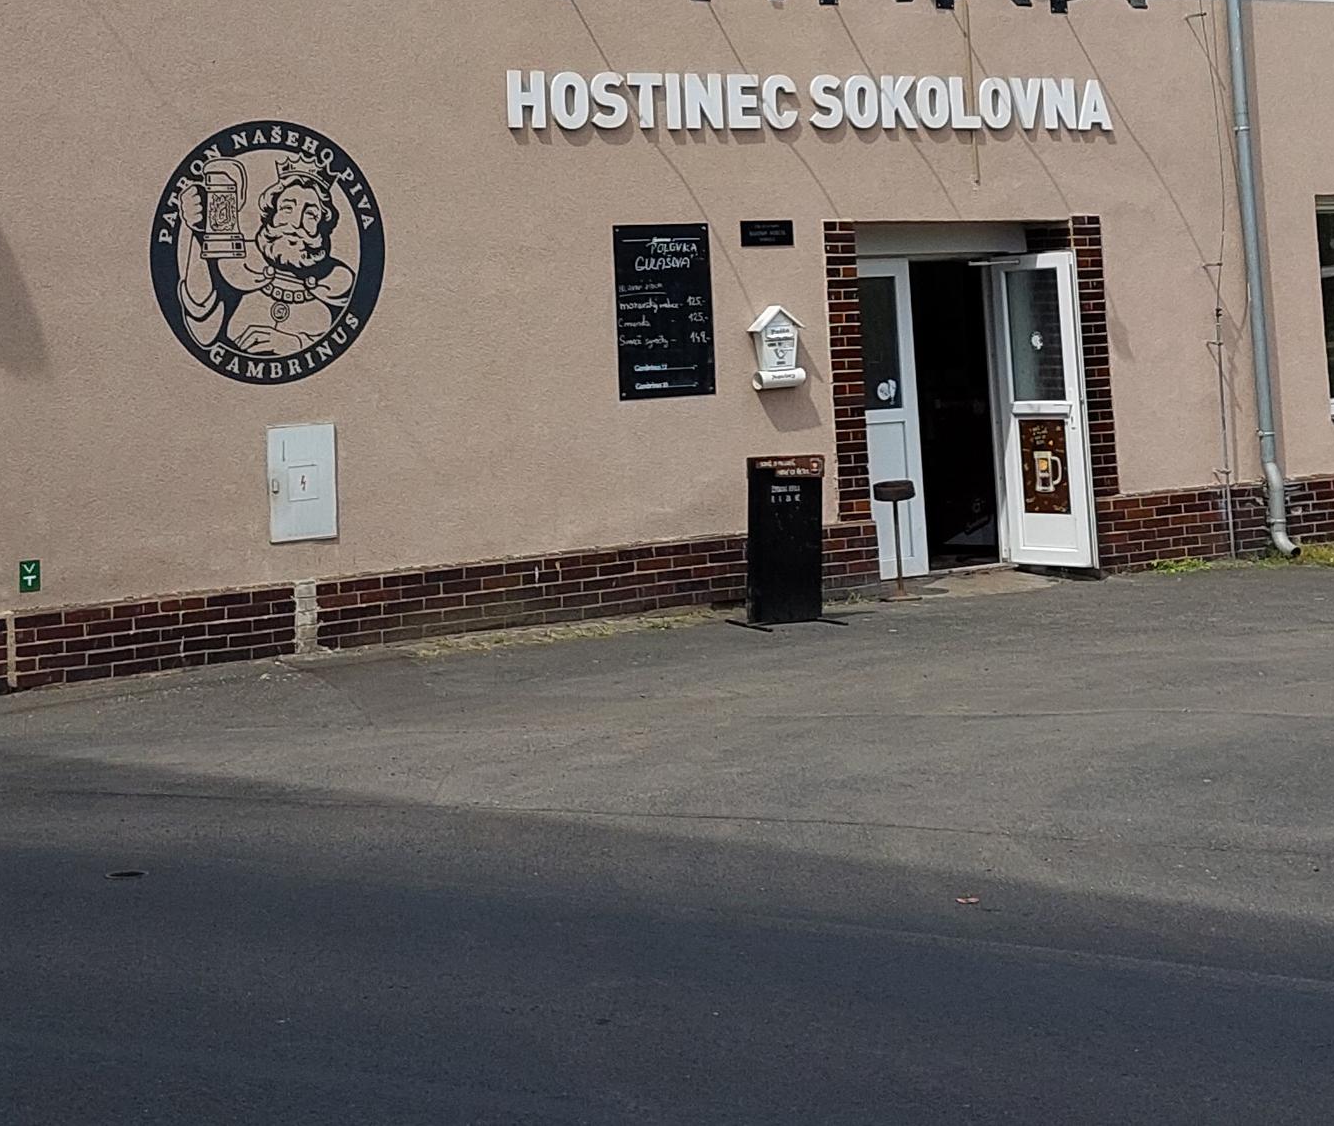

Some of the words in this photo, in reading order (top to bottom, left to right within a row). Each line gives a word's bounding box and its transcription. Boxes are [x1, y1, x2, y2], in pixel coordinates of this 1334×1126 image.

[506, 69, 800, 130] HOSTINEC
[808, 73, 1114, 131] SOKOLOVNA
[158, 143, 222, 245] PATRON
[230, 125, 335, 165] NAŠEHO
[342, 166, 378, 230] PIVA
[208, 311, 360, 380] GAMBRINUS
